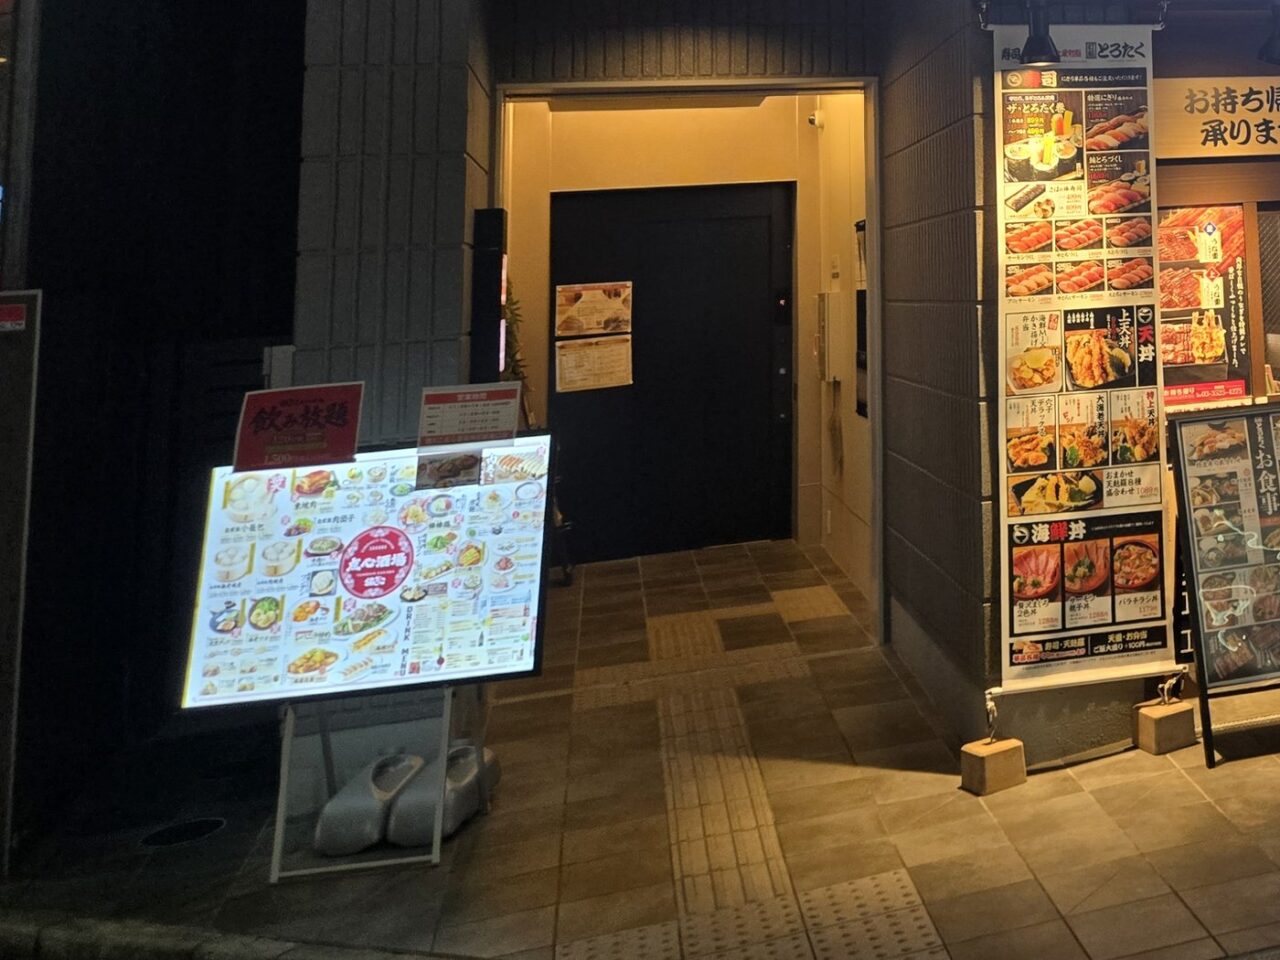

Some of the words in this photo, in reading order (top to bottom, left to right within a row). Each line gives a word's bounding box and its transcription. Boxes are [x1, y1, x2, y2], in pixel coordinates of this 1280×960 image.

[1097, 41, 1146, 59] とろたく
[1118, 308, 1132, 348] 上天丼
[1138, 326, 1155, 362] 天丼
[1105, 470, 1133, 480] おまかせ
[1256, 450, 1280, 516] お食事
[1031, 520, 1087, 543] 海鮮丼
